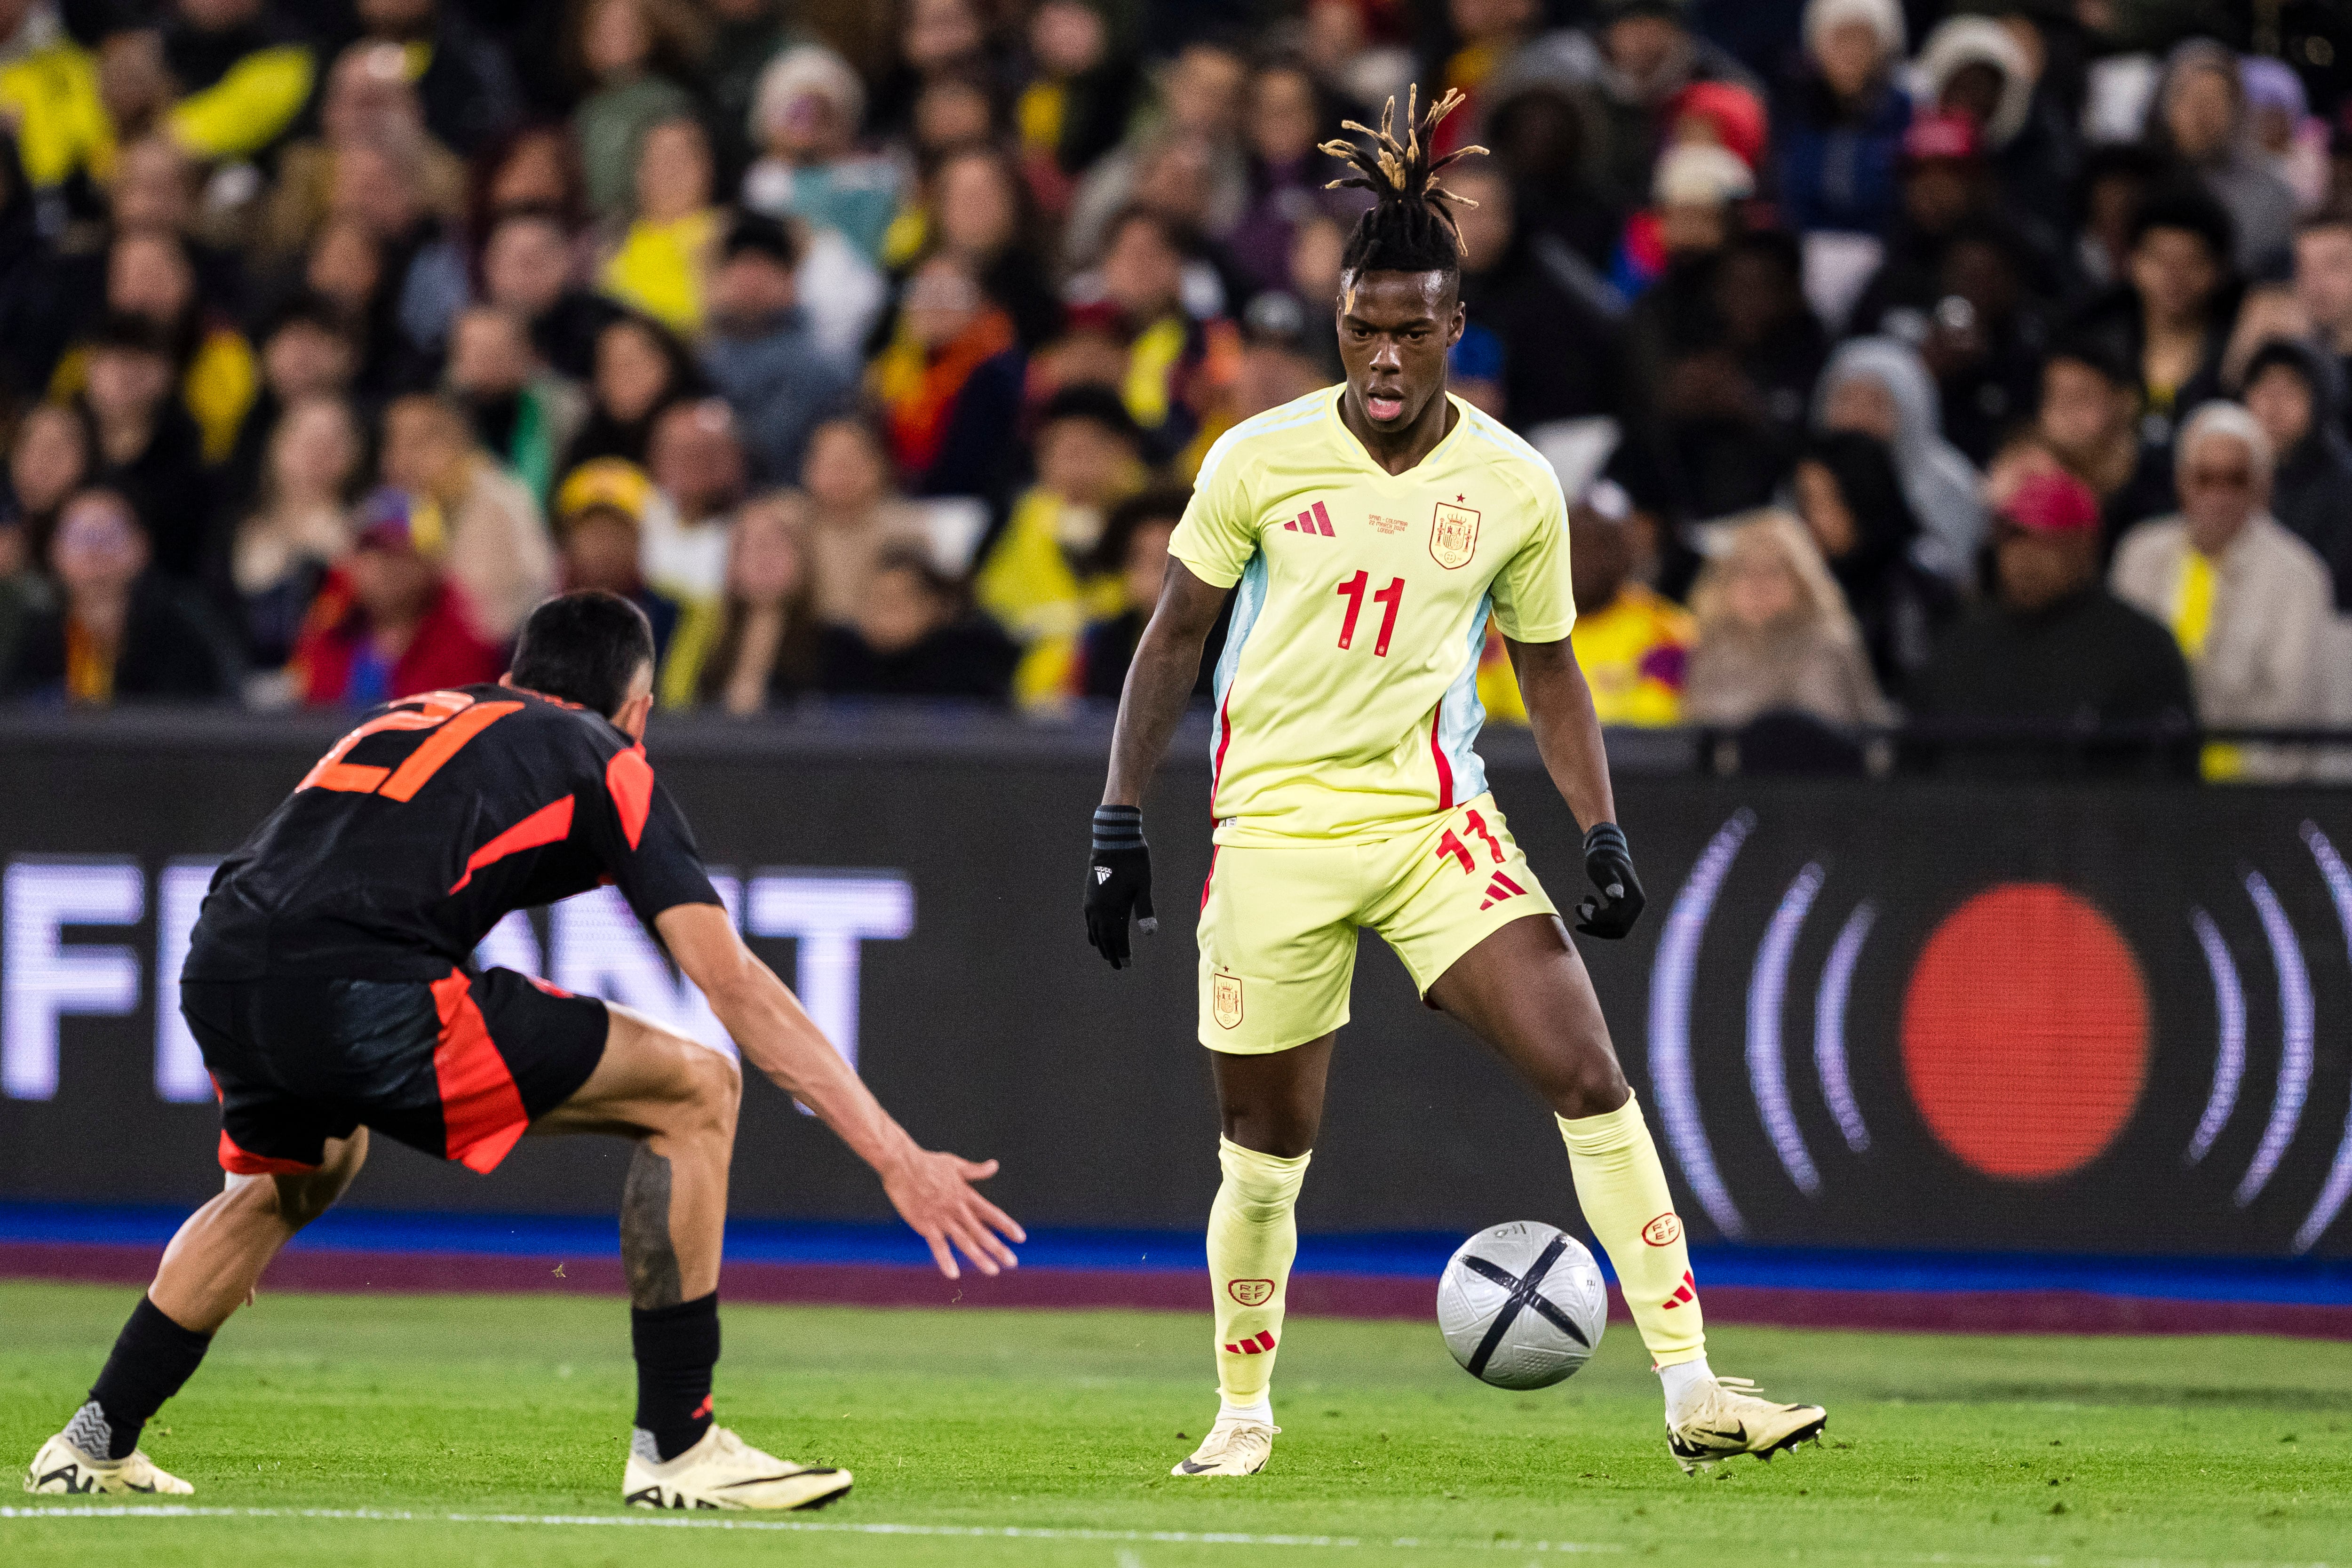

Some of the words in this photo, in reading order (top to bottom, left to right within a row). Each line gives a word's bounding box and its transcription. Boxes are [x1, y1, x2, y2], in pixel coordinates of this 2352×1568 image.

[1385, 518, 1408, 527] COLOMBIA
[1337, 569, 1406, 658] 11
[295, 690, 525, 802] 21
[1435, 809, 1506, 875] 11
